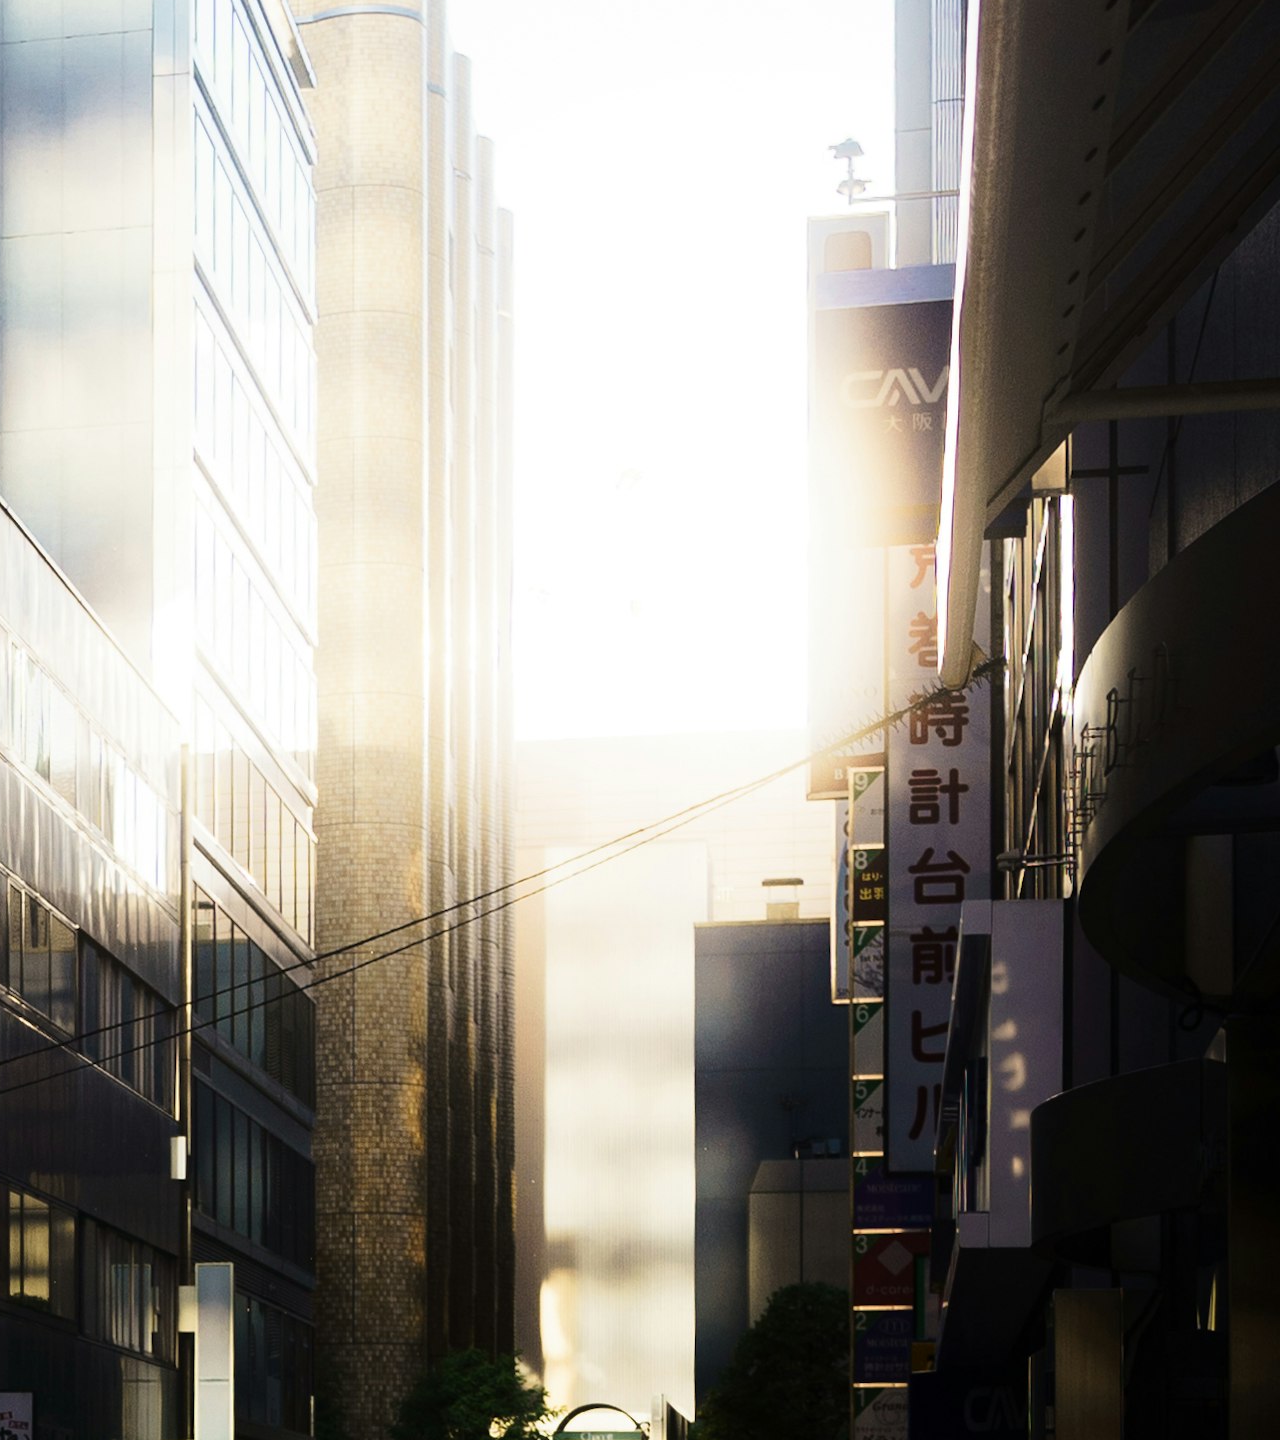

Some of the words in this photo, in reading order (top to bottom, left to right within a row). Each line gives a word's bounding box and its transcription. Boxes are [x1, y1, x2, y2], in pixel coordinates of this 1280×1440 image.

[854, 772, 868, 792] 9
[854, 850, 868, 870] 8
[855, 927, 867, 946] 7
[856, 1005, 869, 1023] 6
[855, 1082, 868, 1100] 5
[855, 1158, 868, 1176] 4
[855, 1236, 868, 1254] 3
[855, 1312, 867, 1331] 2
[857, 1390, 865, 1408] 1
